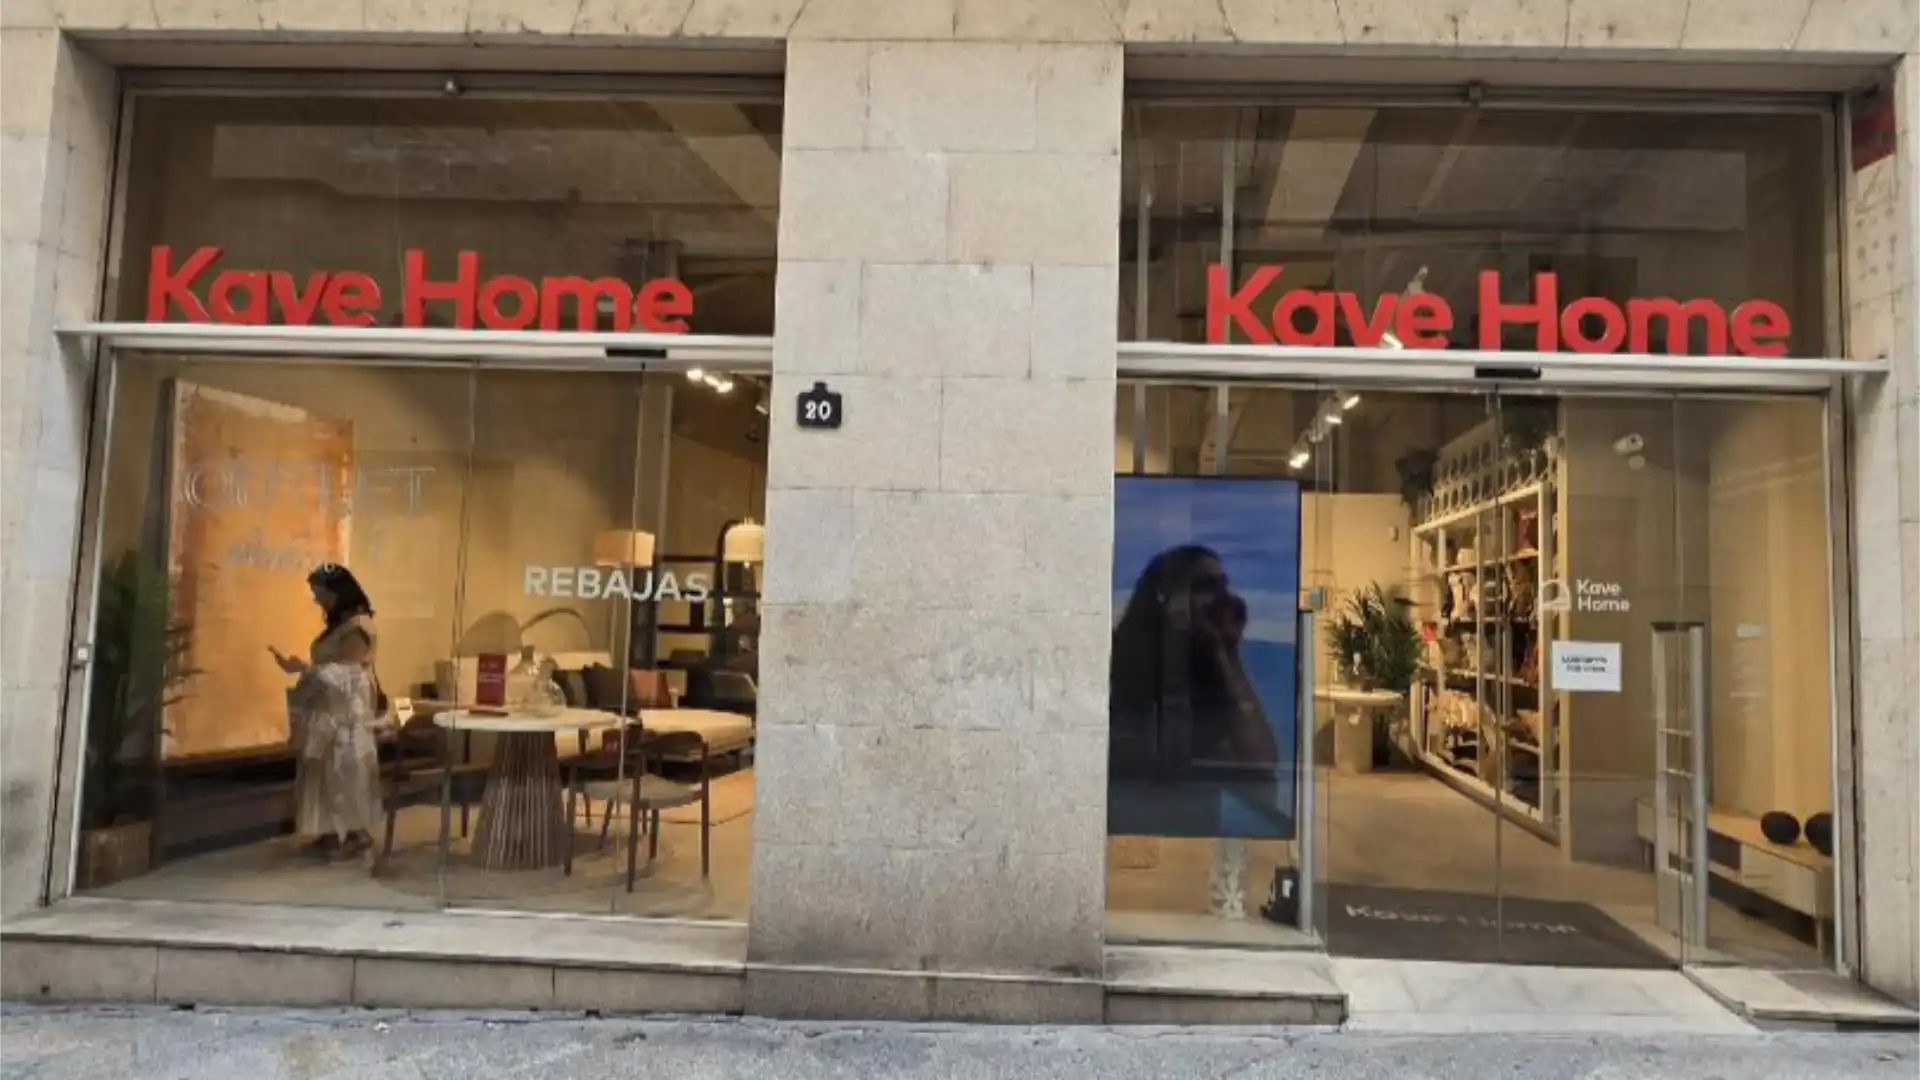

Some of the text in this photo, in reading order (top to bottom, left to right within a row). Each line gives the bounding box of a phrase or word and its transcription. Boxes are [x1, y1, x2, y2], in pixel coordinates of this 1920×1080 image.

[146, 245, 694, 333] Kave Home
[1206, 262, 1791, 356] Kave Home
[805, 399, 831, 421] 20
[524, 565, 709, 603] REBAJAS
[1577, 578, 1621, 595] Kave
[1578, 596, 1631, 612] Home
